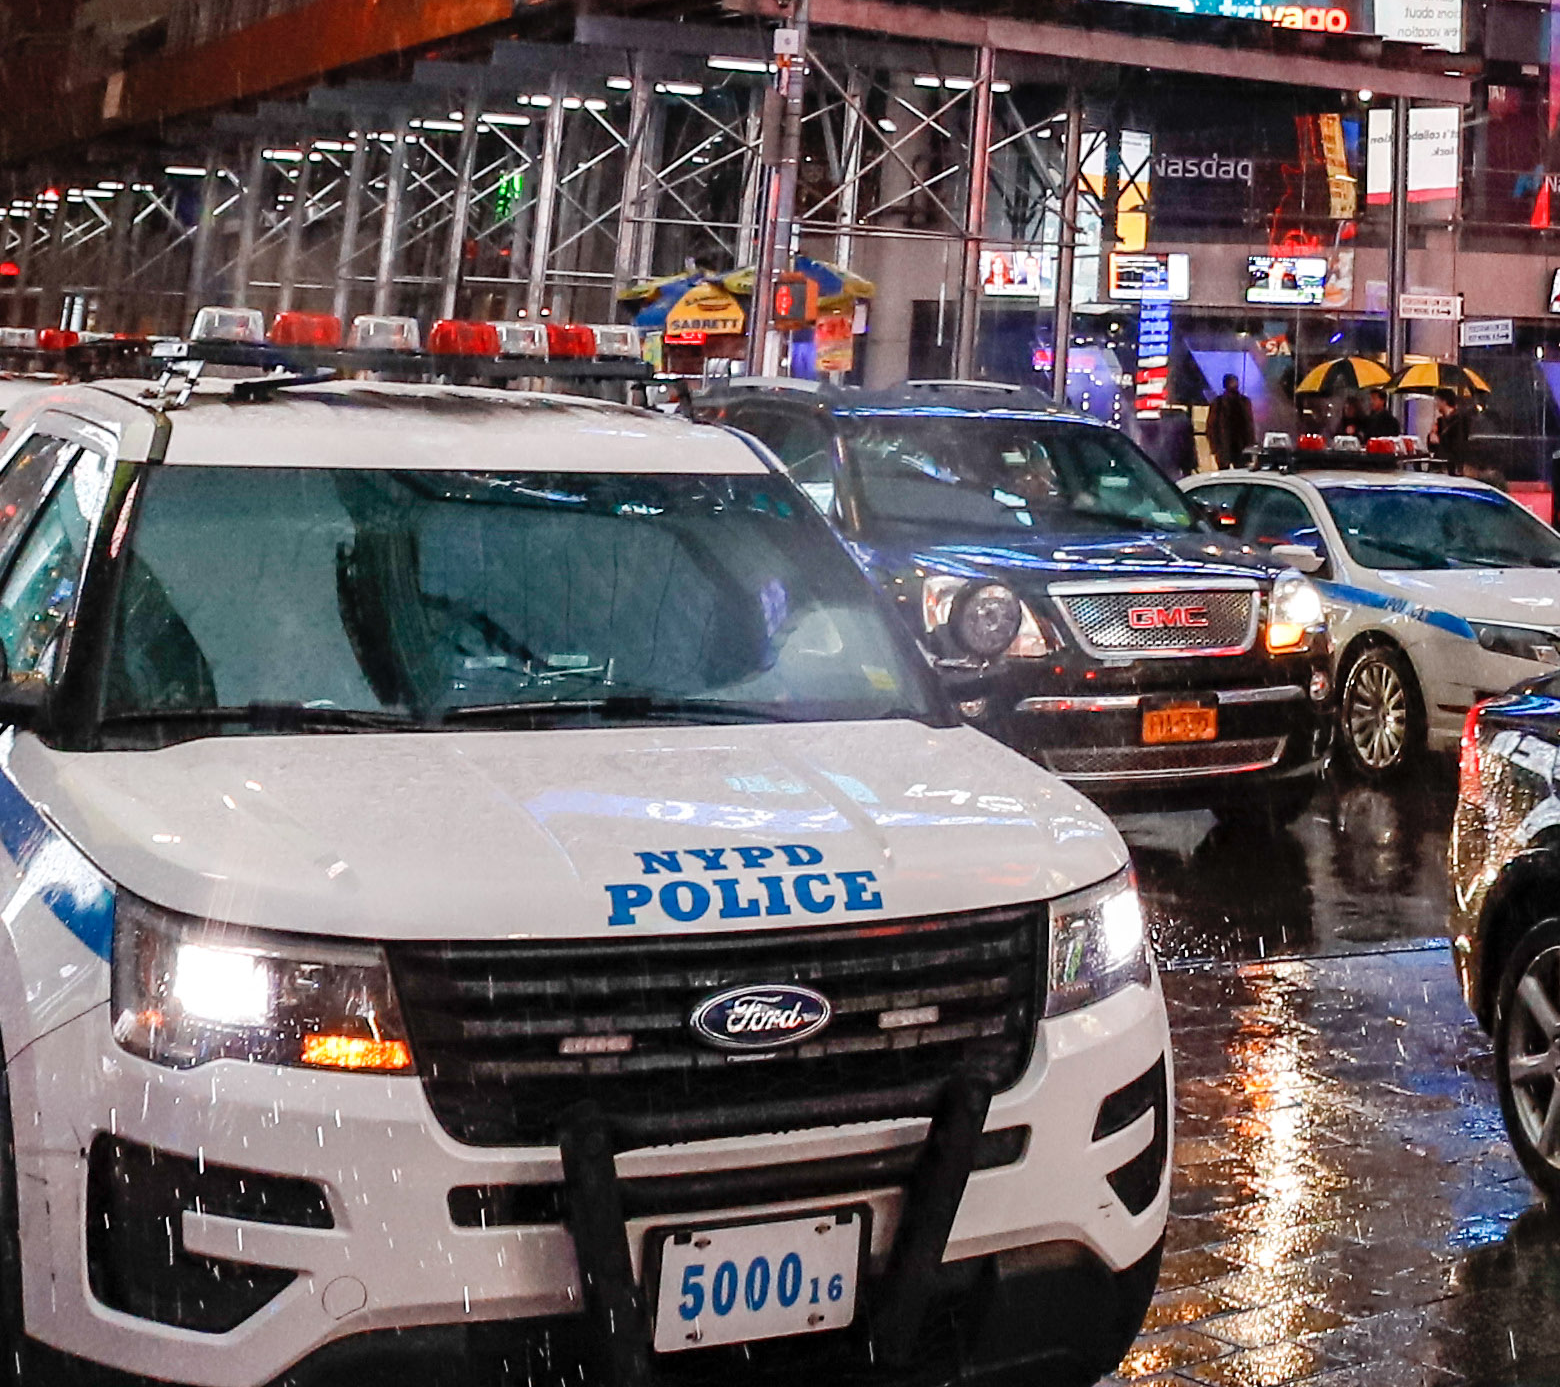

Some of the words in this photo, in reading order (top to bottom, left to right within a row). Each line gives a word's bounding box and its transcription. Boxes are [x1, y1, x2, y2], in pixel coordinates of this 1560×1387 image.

[671, 318, 740, 331] SABRETT
[1128, 606, 1209, 629] GMC
[633, 843, 824, 875] NYPD
[603, 869, 884, 927] POLICE
[724, 994, 803, 1034] Ford
[678, 1250, 804, 1322] 5000
